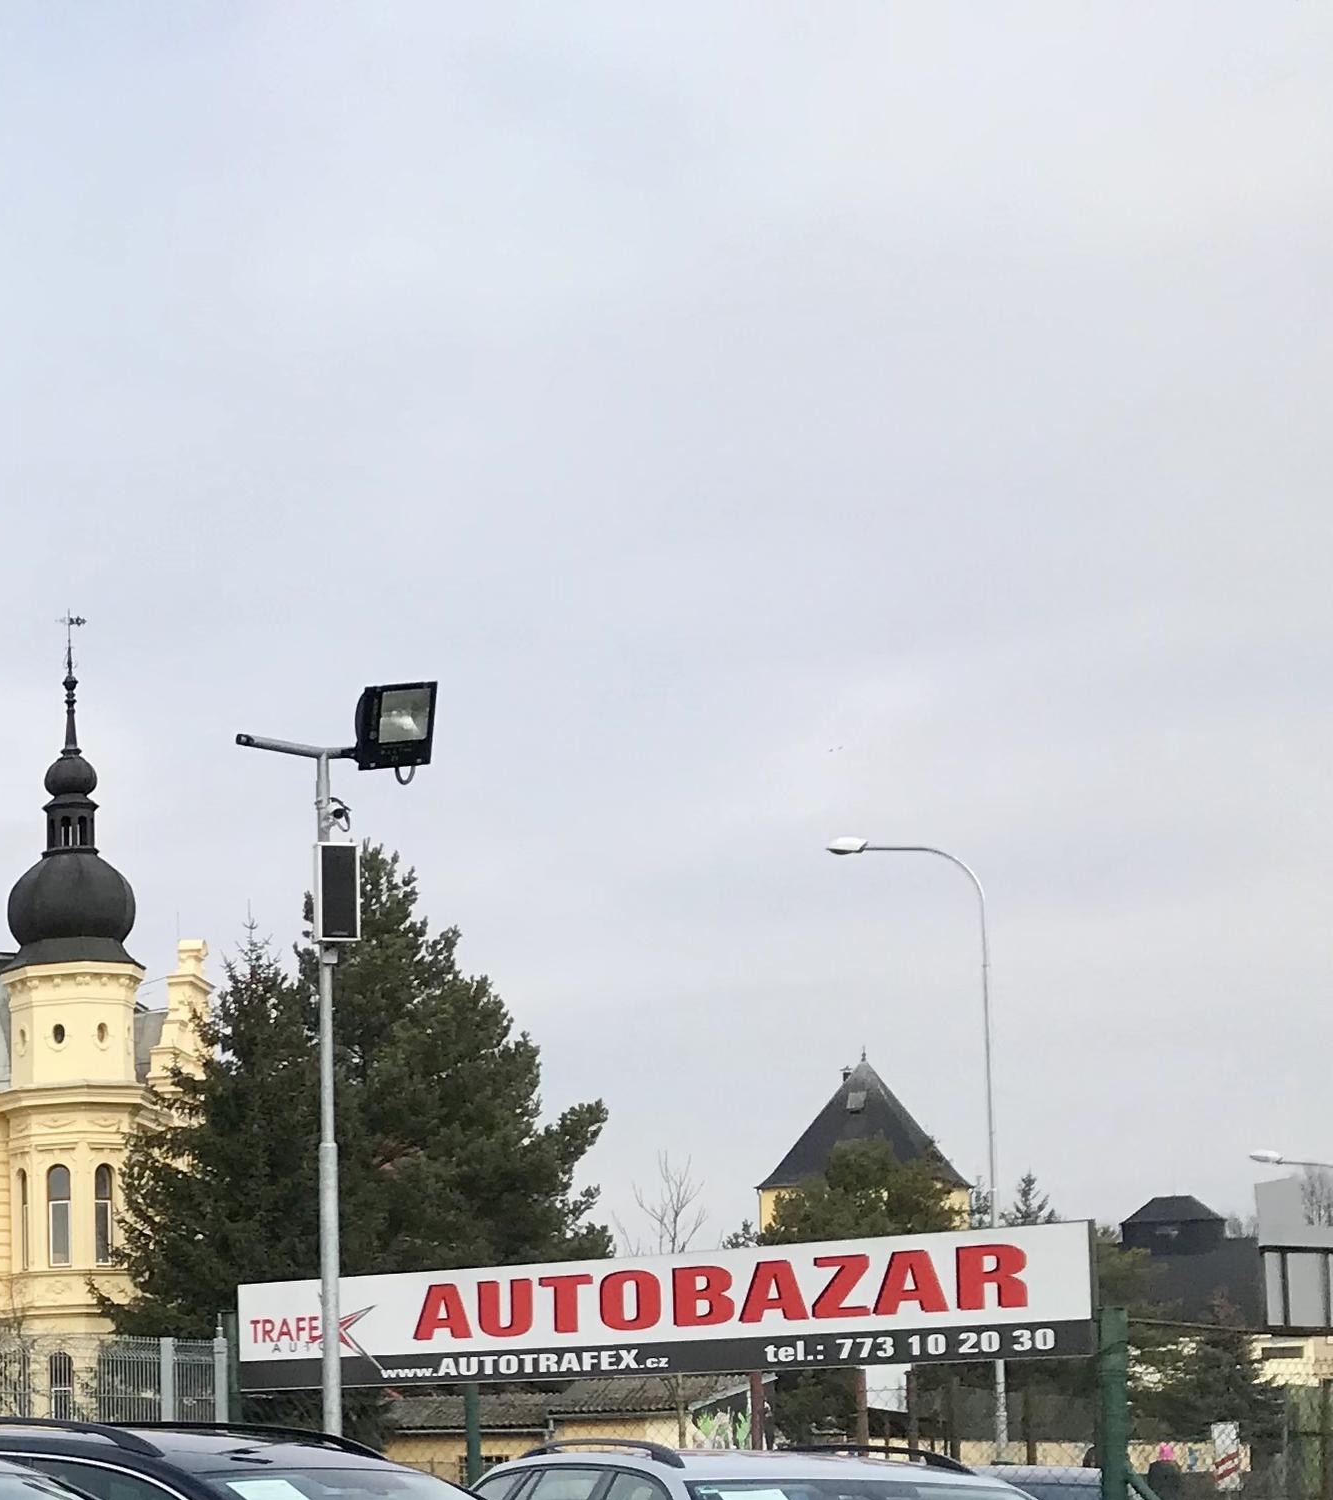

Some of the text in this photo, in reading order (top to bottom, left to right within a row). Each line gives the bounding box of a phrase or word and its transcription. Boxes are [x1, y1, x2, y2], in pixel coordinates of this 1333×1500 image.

[412, 1243, 1028, 1341] AUTOBAZAR
[764, 1328, 1056, 1363] tel.: 773 10 20 30
[381, 1348, 669, 1379] www.AUTOTRAFEX.cz
